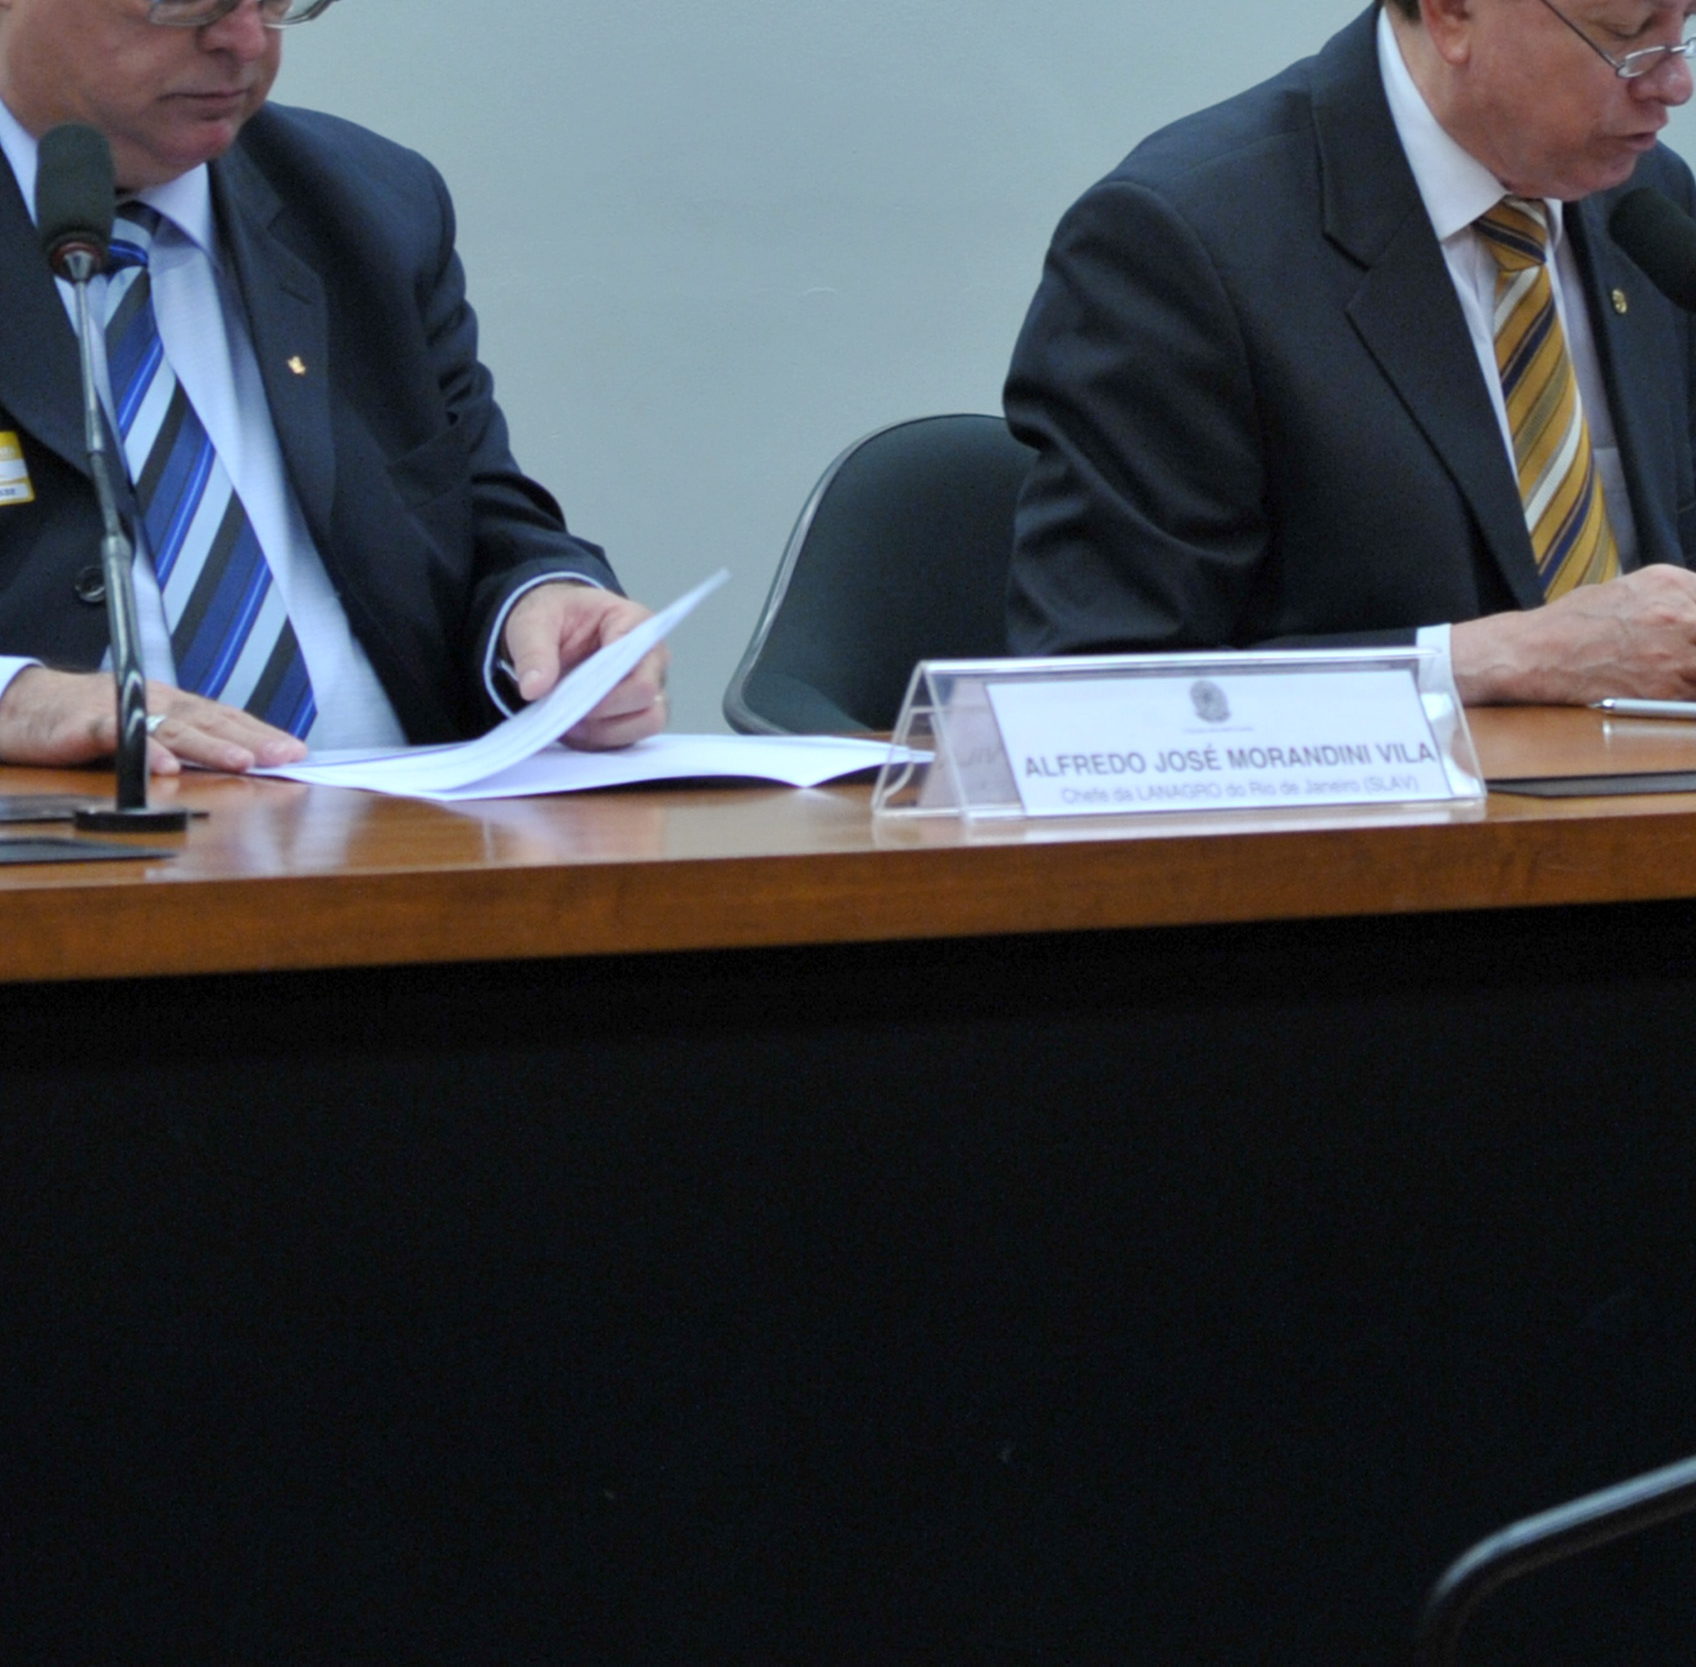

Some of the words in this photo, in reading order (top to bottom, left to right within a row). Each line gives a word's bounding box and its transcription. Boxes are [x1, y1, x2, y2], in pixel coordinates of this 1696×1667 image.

[1025, 750, 1147, 778] ALFREDO
[1154, 742, 1222, 774] JOSÉ
[1226, 743, 1372, 770] MORANDINI
[1375, 741, 1436, 765] VILA
[1061, 787, 1109, 804] Chefe
[1113, 786, 1134, 802] da
[1137, 783, 1222, 801] LANAGRO
[1226, 782, 1246, 798] do
[1249, 781, 1275, 796] Rio
[1279, 779, 1300, 796] de
[1305, 777, 1360, 795] Janeiro
